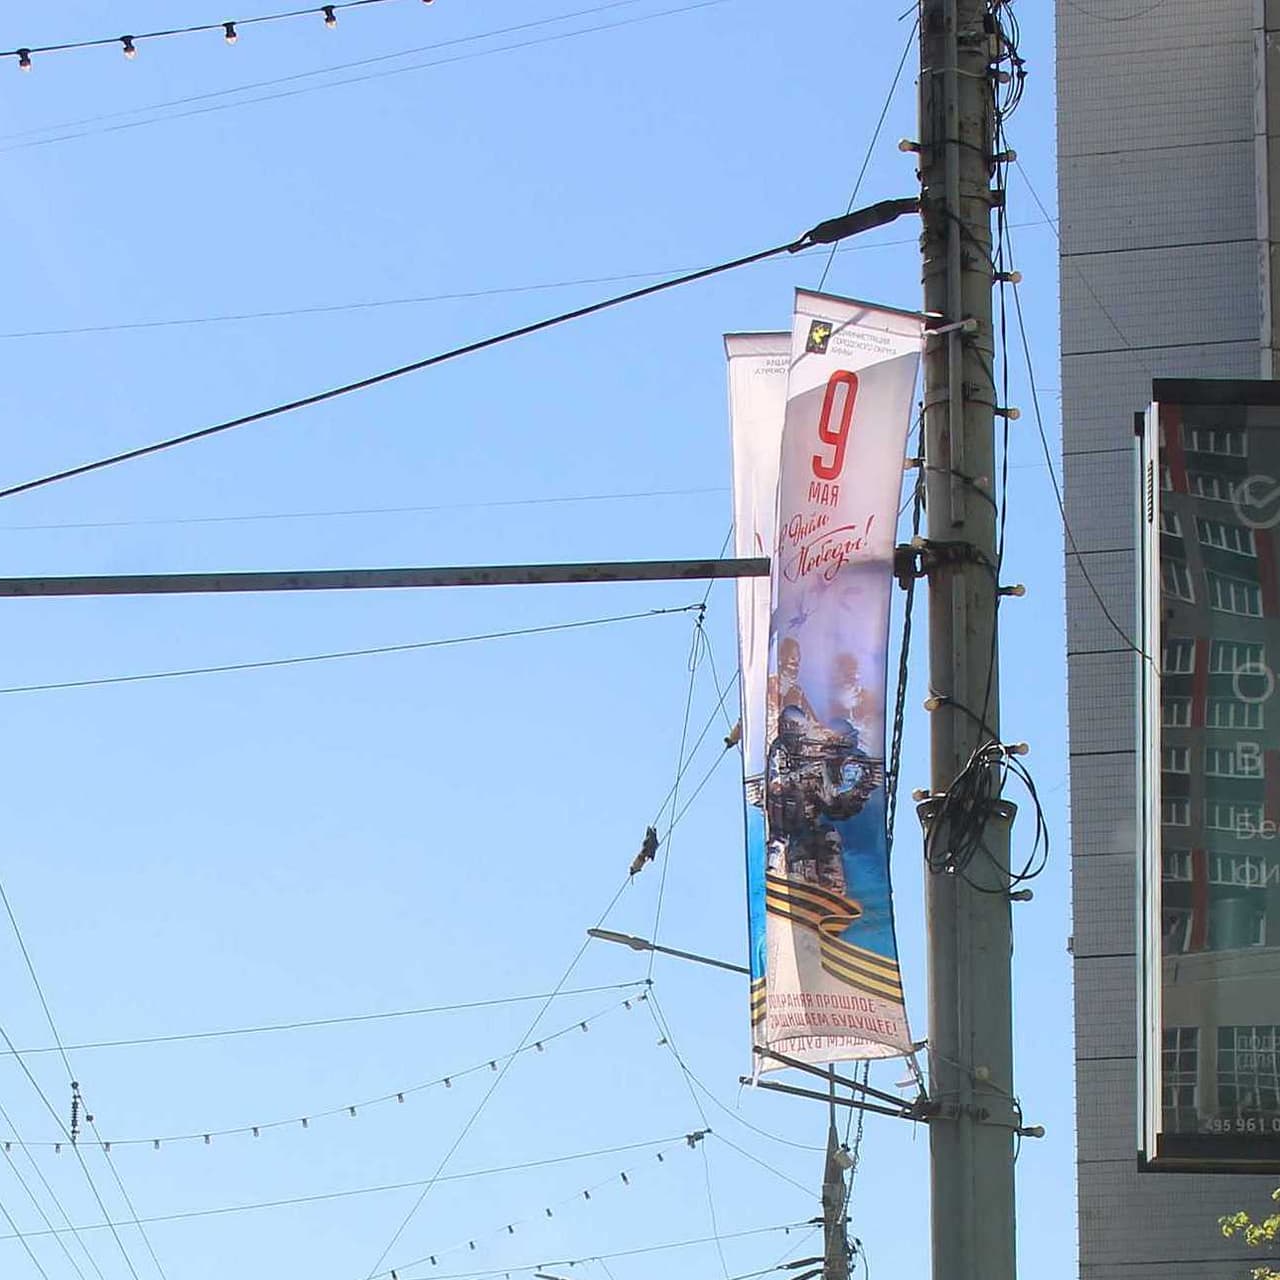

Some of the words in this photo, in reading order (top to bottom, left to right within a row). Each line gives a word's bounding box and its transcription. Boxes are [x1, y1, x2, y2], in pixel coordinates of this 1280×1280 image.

[811, 369, 859, 481] 9
[808, 481, 840, 507] МАЯ
[1236, 741, 1263, 772] в
[816, 993, 876, 1012] ПРОШЛОЕ
[832, 1013, 898, 1036] БУДУЩЕЕ!
[1236, 1118, 1265, 1134] 961
